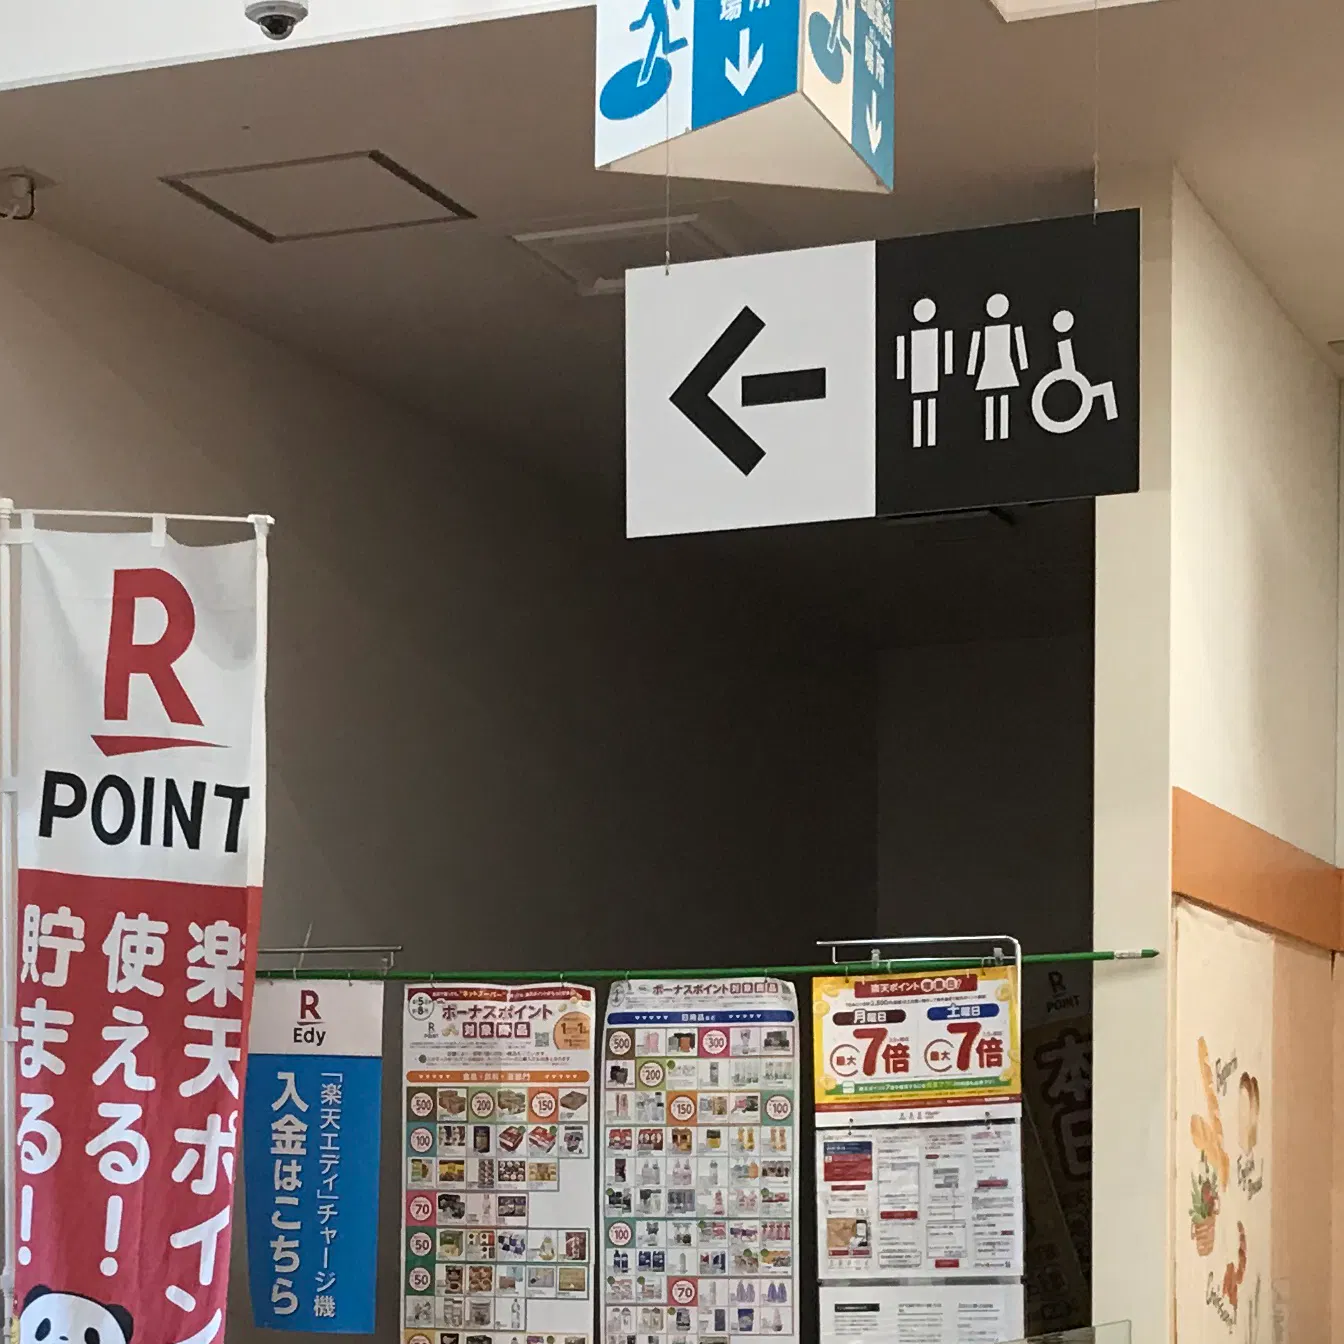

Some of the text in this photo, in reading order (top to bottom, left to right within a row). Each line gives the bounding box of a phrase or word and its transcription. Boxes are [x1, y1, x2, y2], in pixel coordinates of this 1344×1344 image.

[104, 567, 204, 726] R
[38, 769, 250, 853] POINT
[299, 989, 321, 1022] R
[1046, 994, 1081, 1013] POINT
[442, 1004, 553, 1020] ボーナスポイント
[854, 1009, 887, 1024] 月曜日
[947, 1003, 981, 1019] 土曜日
[292, 1026, 327, 1047] Edy
[708, 1037, 724, 1048] 300
[613, 1038, 630, 1049] 500
[947, 1021, 1004, 1072] 7倍
[853, 1027, 910, 1077] 7倍
[645, 1069, 661, 1081] 200
[17, 904, 86, 1266] 貯まる!
[84, 911, 169, 1277] 使える!
[416, 1099, 432, 1111] 500
[476, 1099, 491, 1111] 200
[538, 1099, 553, 1111] 150
[676, 1104, 692, 1115] 150
[773, 1103, 788, 1114] 100
[416, 1135, 431, 1147] 100
[269, 1071, 309, 1317] 入金はこちら
[314, 1071, 343, 1318] 「楽天エディ」チャージ機
[415, 1203, 430, 1215] 70
[614, 1229, 629, 1240] 100
[415, 1239, 430, 1251] 50
[415, 1274, 429, 1286] 50
[677, 1287, 692, 1298] 70
